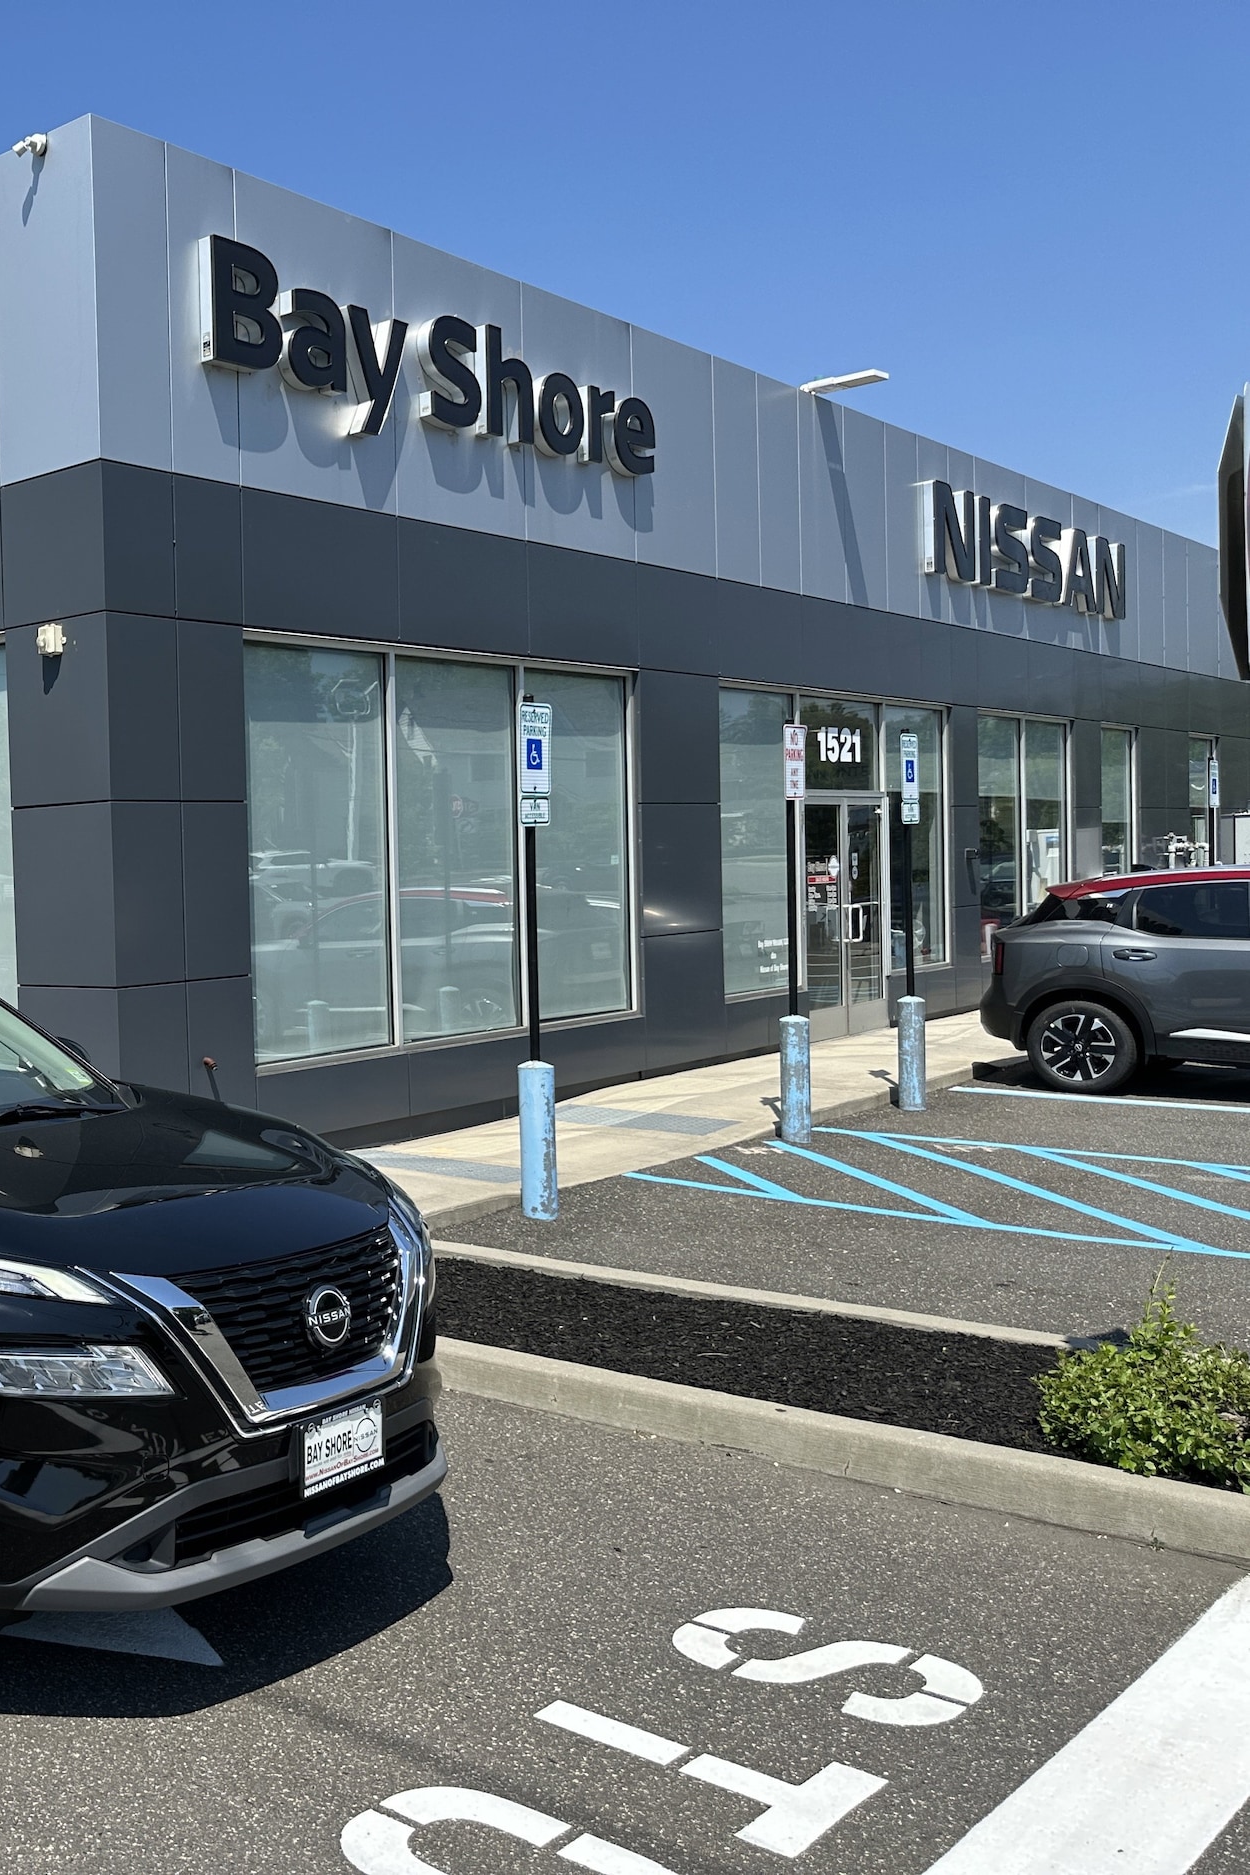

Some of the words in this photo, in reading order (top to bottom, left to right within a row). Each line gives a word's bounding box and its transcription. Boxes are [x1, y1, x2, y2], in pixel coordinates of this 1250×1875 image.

[201, 234, 408, 437] Bay
[419, 315, 656, 478] Shore
[927, 479, 1126, 620] NISSAN
[521, 710, 549, 724] RESERVED
[523, 724, 547, 738] PARKING
[790, 730, 799, 746] NO
[817, 726, 862, 764] 1521
[785, 748, 804, 762] PARKING
[307, 1305, 351, 1327] NISSAN
[306, 1441, 324, 1466] BAY
[324, 1430, 353, 1459] SHORE
[353, 1427, 379, 1442] NISSAN
[304, 1457, 385, 1498] NISSANOFBAYSHORE.COM
